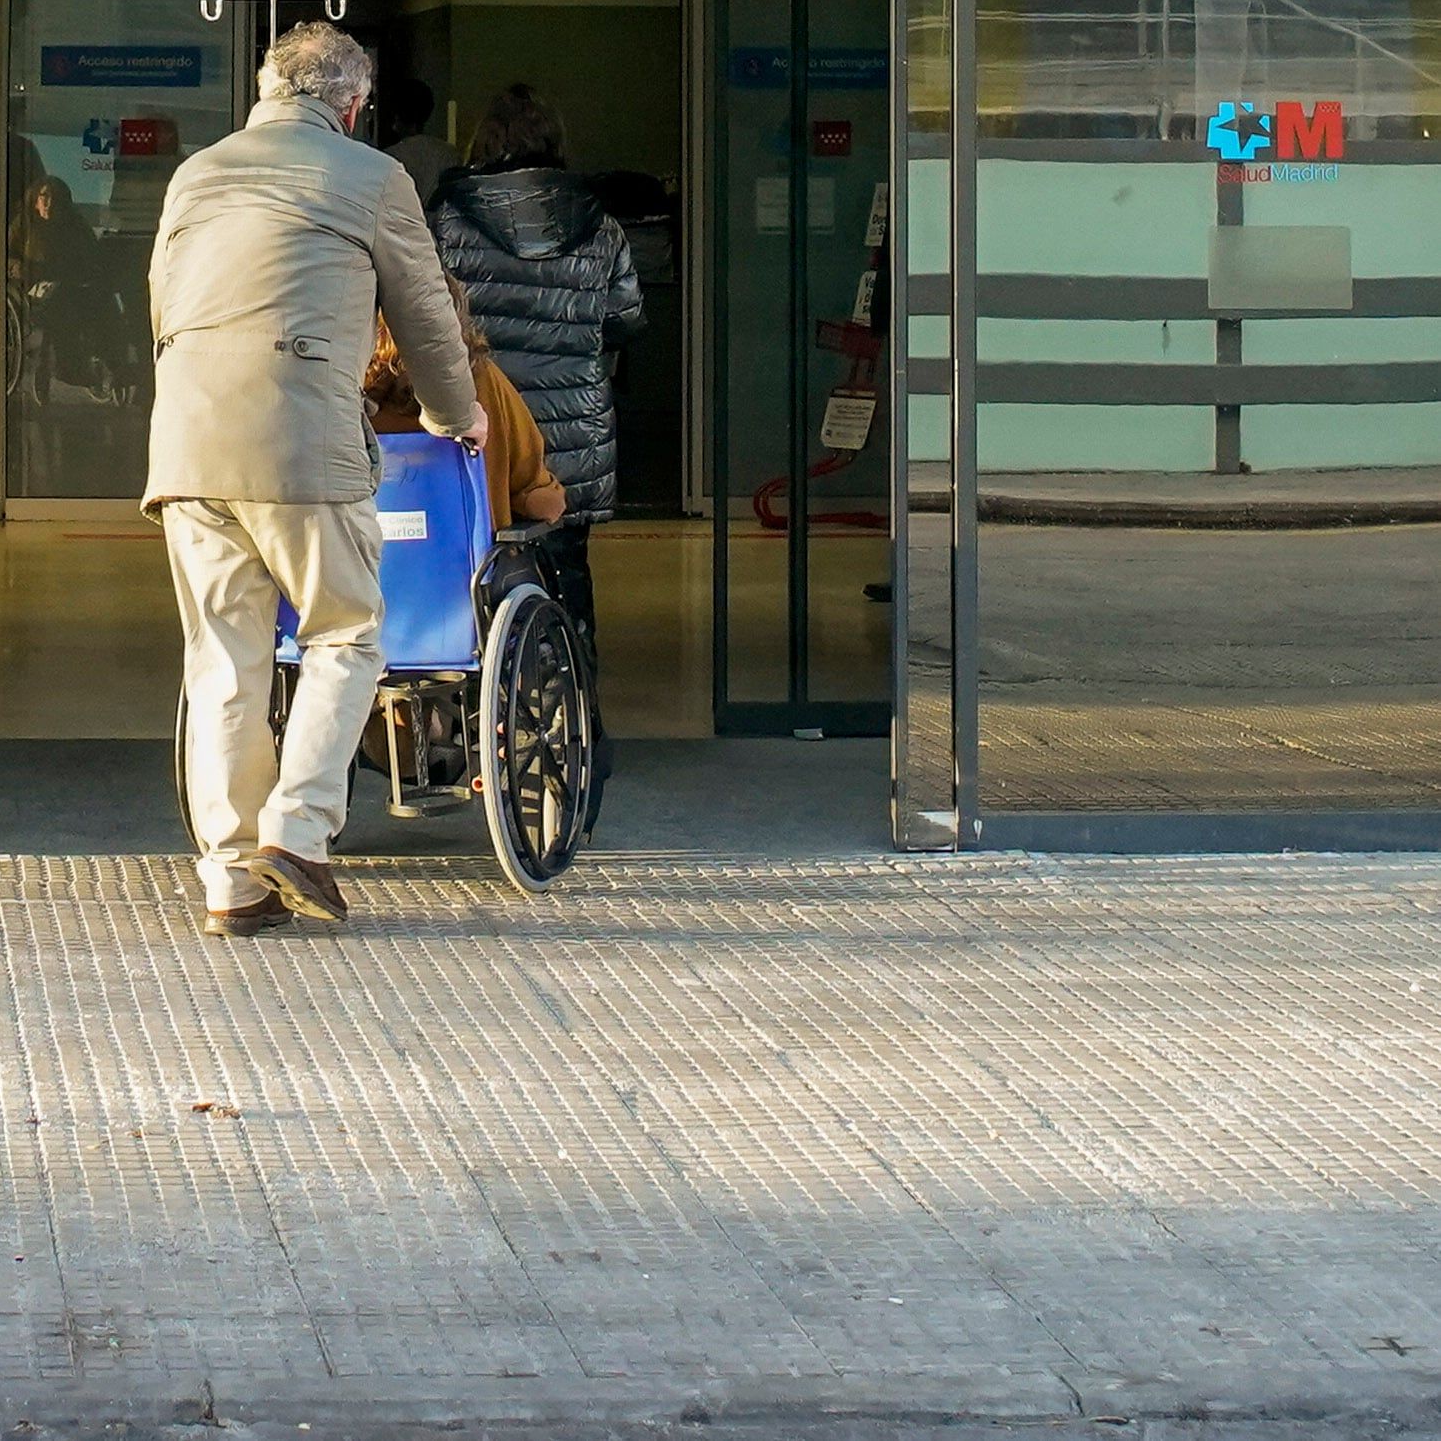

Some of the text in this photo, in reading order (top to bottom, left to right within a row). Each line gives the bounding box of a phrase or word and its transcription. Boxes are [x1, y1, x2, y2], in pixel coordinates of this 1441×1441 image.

[78, 55, 193, 70] Acceso restringido
[1217, 163, 1339, 184] SaludMadrid
